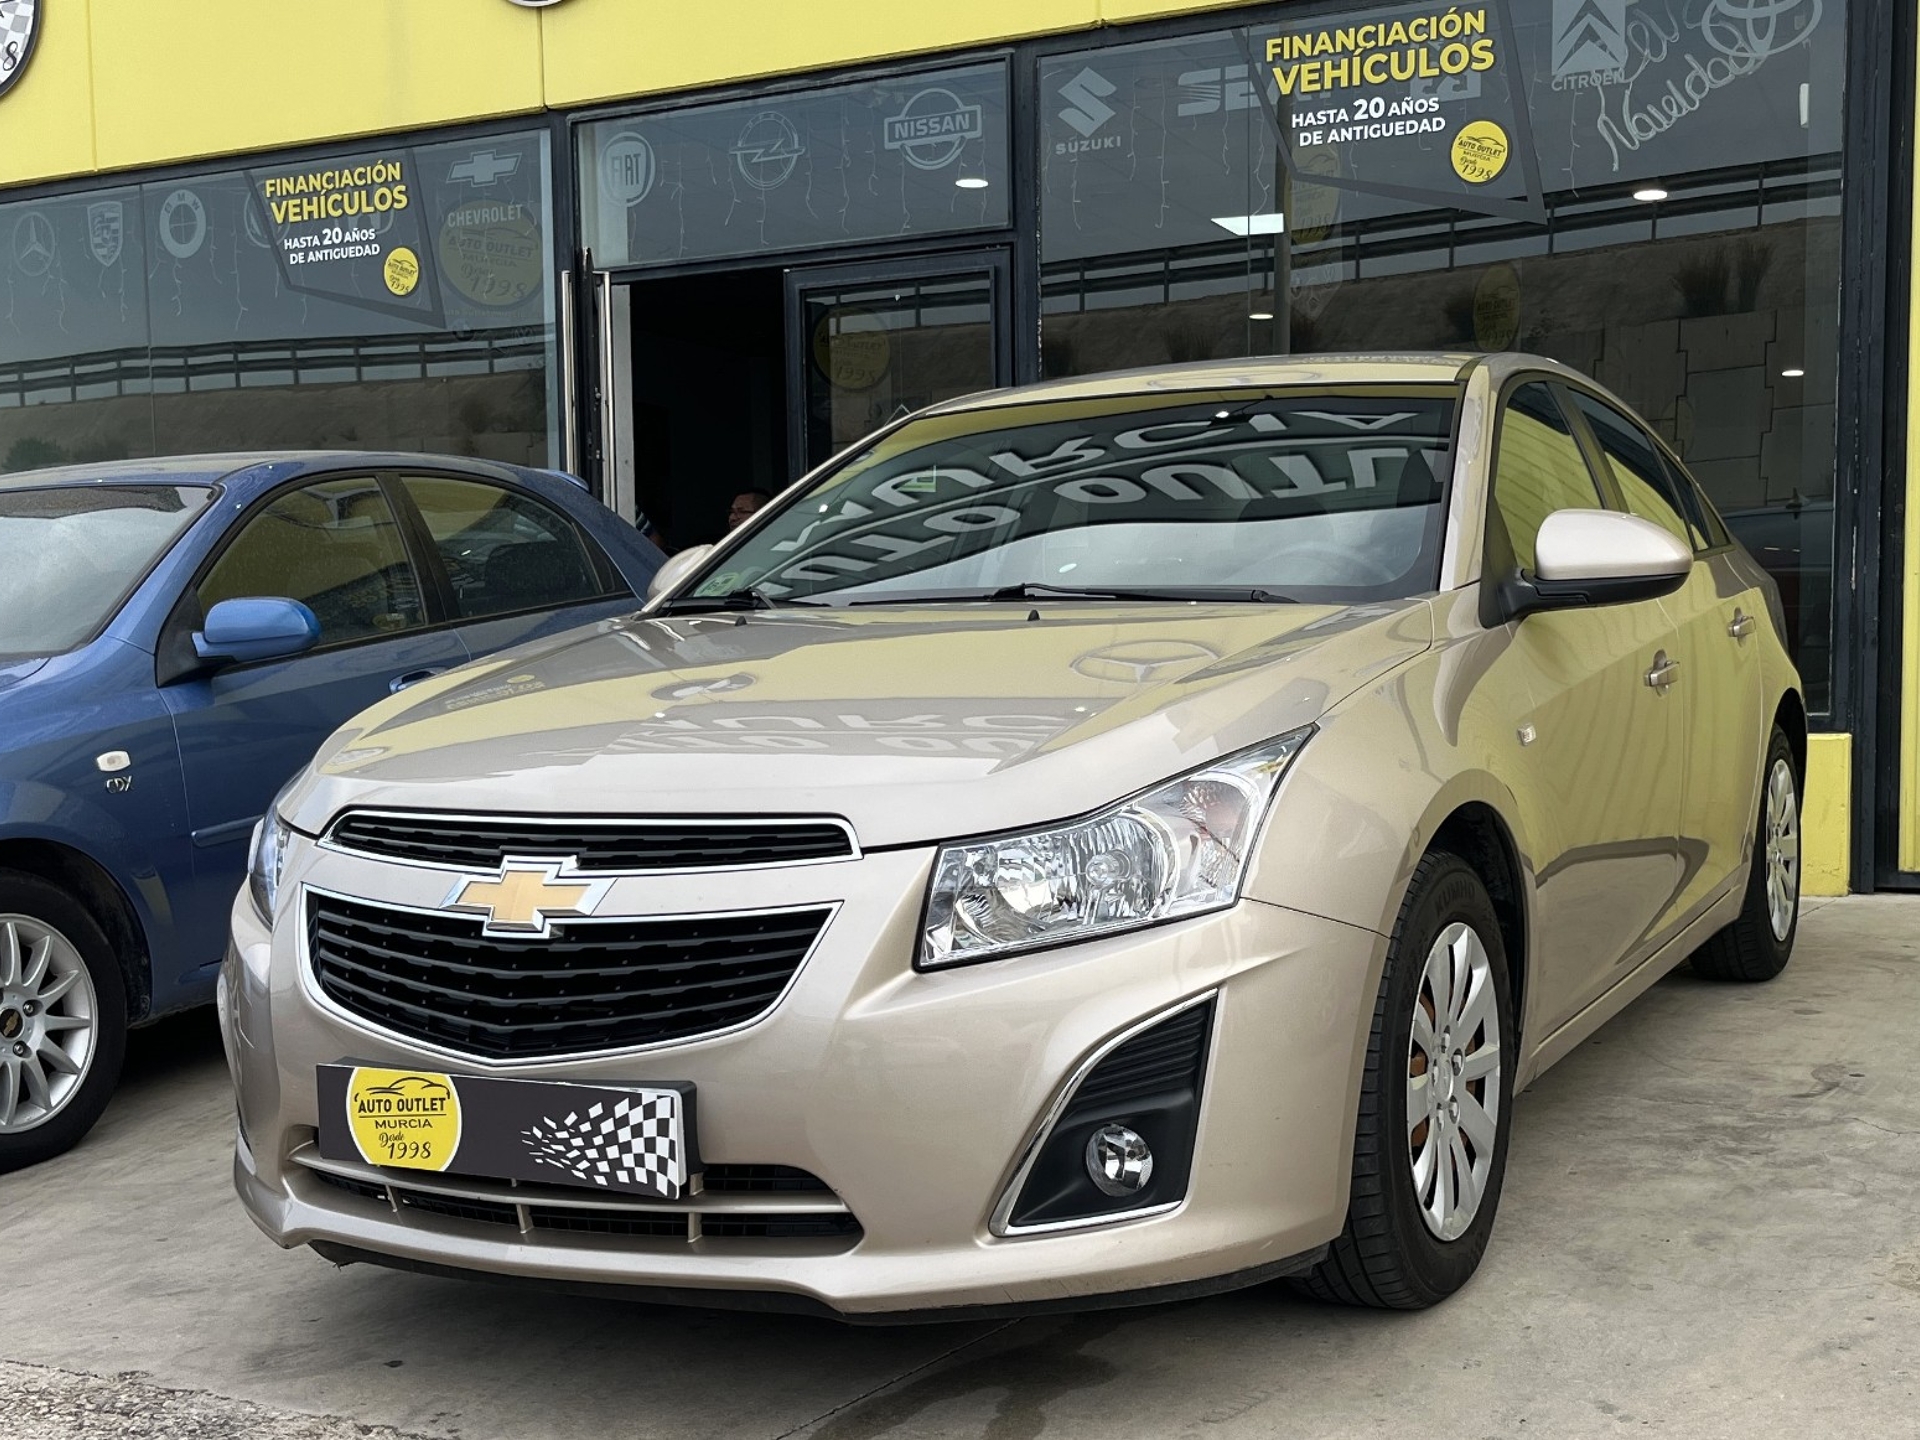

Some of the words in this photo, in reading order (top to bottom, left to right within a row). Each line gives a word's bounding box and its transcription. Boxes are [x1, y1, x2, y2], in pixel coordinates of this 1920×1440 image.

[1266, 7, 1486, 62] FINANCIACIÓN
[1273, 39, 1494, 95] VEHÍCULOS
[1292, 108, 1349, 128] HASTA
[1353, 97, 1385, 120] 20
[1387, 97, 1440, 117] AÑOS
[894, 113, 970, 139] NISSAN
[1299, 130, 1322, 147] DE
[1327, 117, 1446, 144] ANTIGUEDAD
[1055, 136, 1122, 155] SUZUKI
[1458, 140, 1476, 150] AUTO
[1477, 145, 1503, 157] OUTLET
[265, 160, 401, 198] FINANCIACIÓN
[611, 153, 643, 187] FIAT
[270, 185, 408, 224] VEHÍCULOS
[447, 203, 523, 228] CHEVROLET
[284, 235, 320, 250] HASTA
[322, 227, 342, 245] 20
[344, 228, 376, 243] AÑOS
[486, 241, 534, 258] OUTLET
[289, 252, 305, 265] DE
[307, 243, 380, 263] ANTIGUEDAD
[106, 775, 134, 793] CDX
[358, 1098, 392, 1114] AUTO
[397, 1097, 446, 1112] OUTLET
[374, 1118, 433, 1129] MURCIA
[387, 1141, 431, 1159] 1998
